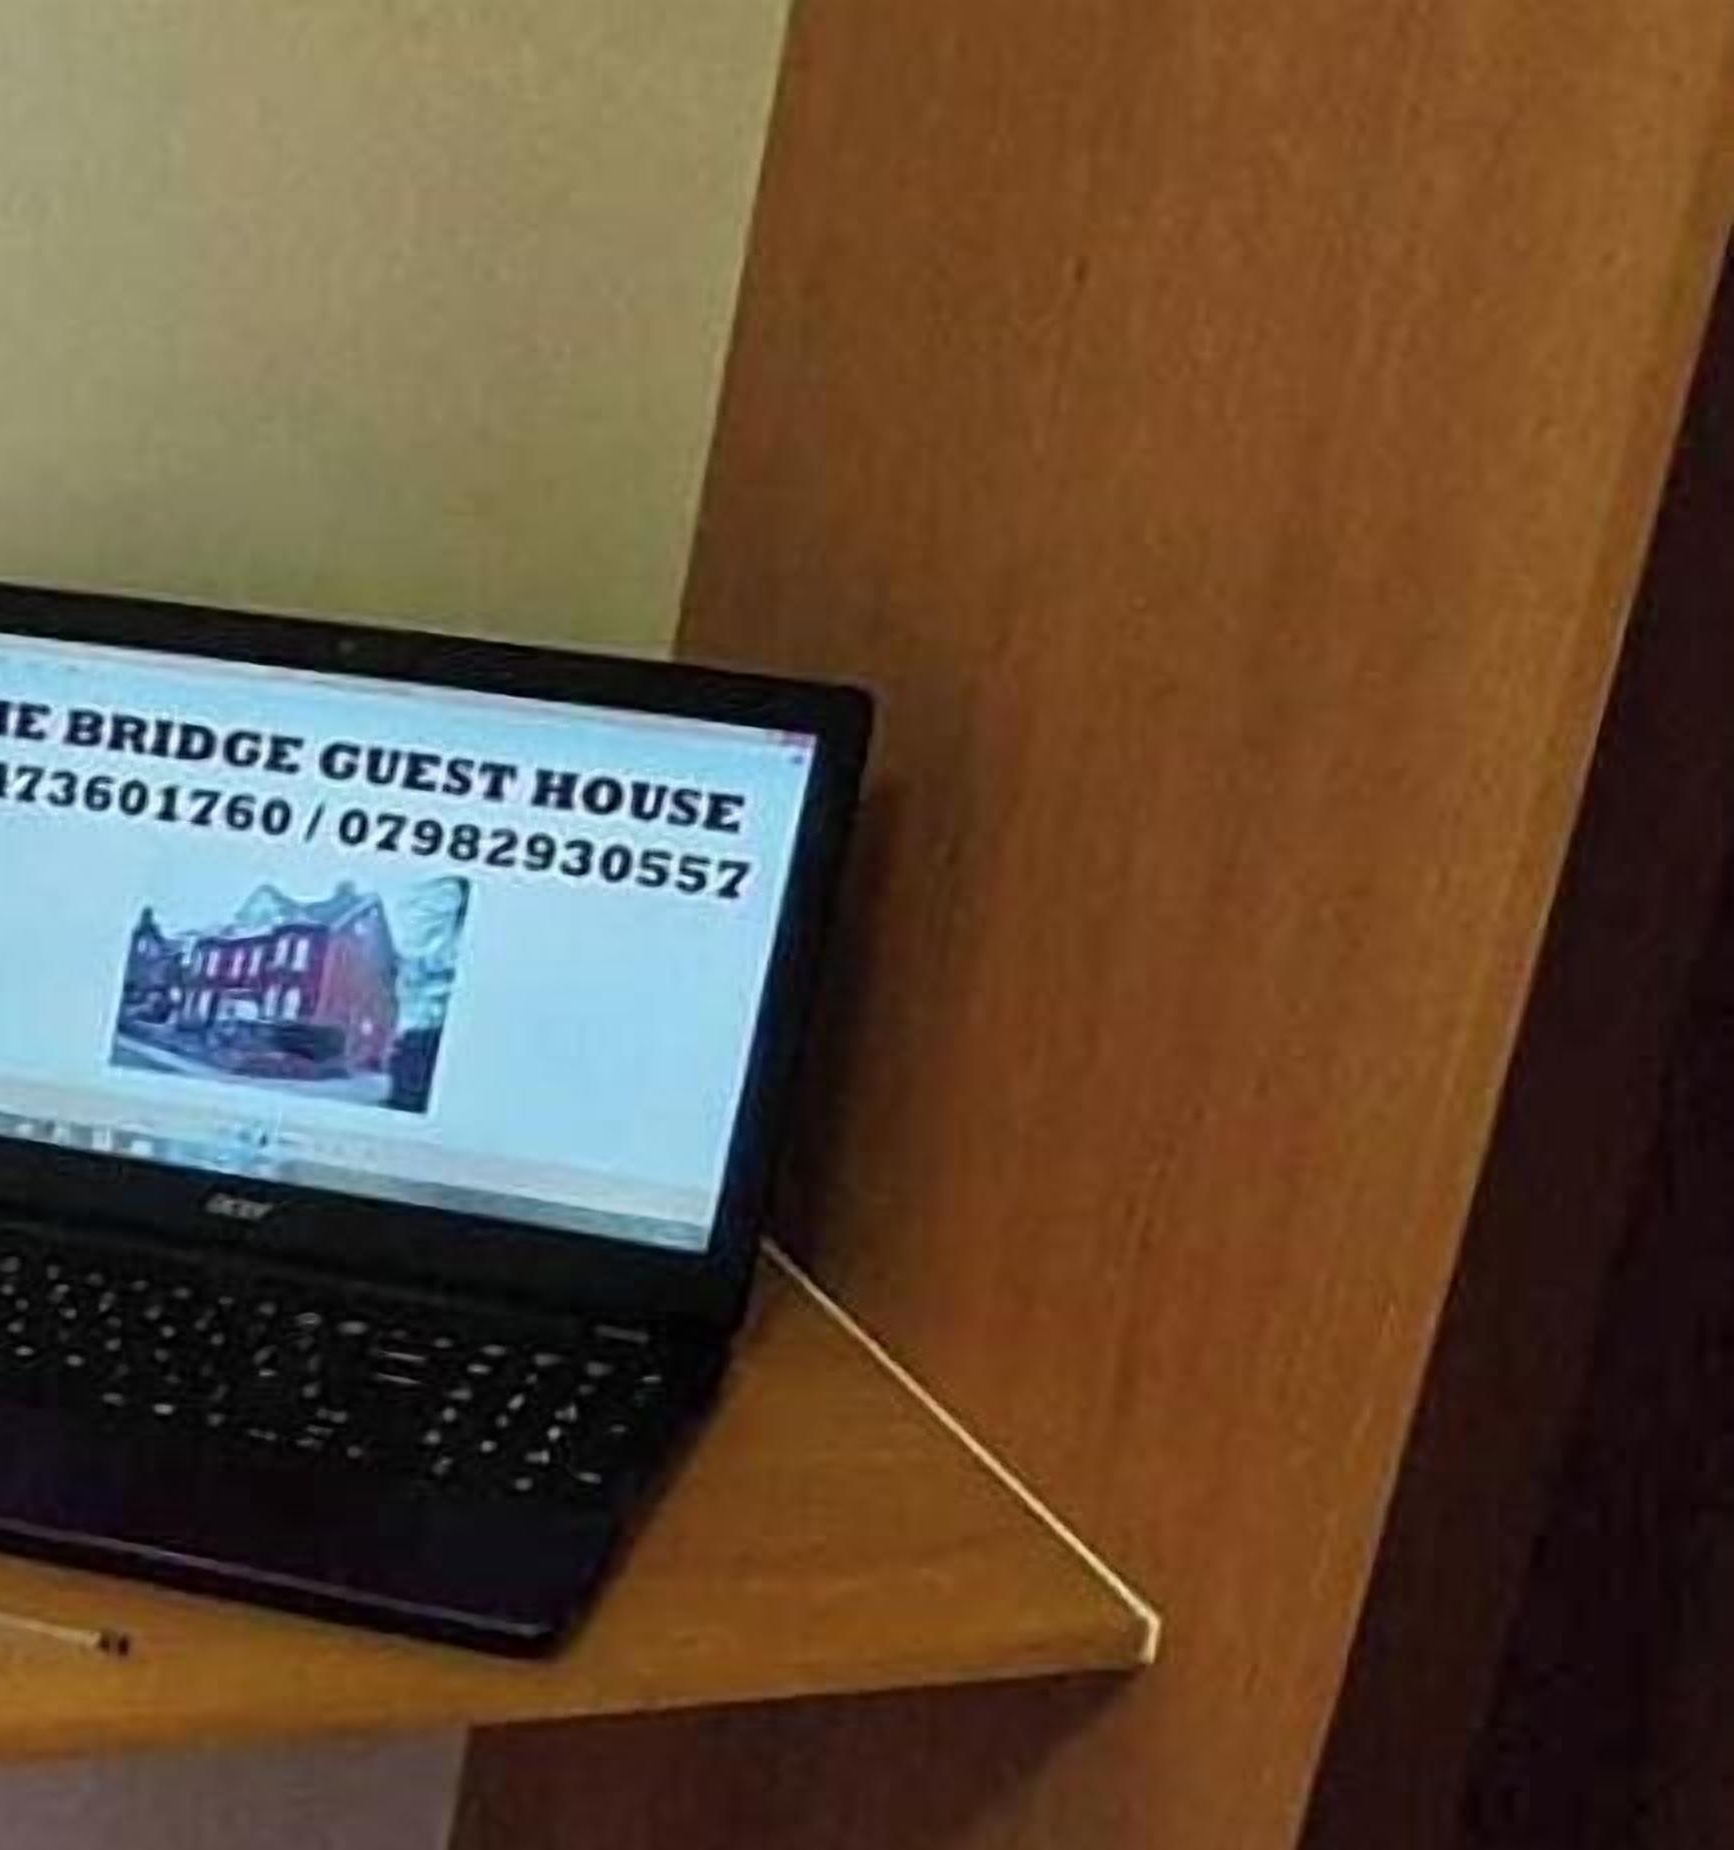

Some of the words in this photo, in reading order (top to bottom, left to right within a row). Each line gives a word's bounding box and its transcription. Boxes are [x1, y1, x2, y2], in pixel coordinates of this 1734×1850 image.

[64, 709, 304, 775] BRIDGE
[319, 742, 518, 801] GUEST
[530, 768, 745, 834] HOUSE
[338, 808, 750, 900] 07982930557
